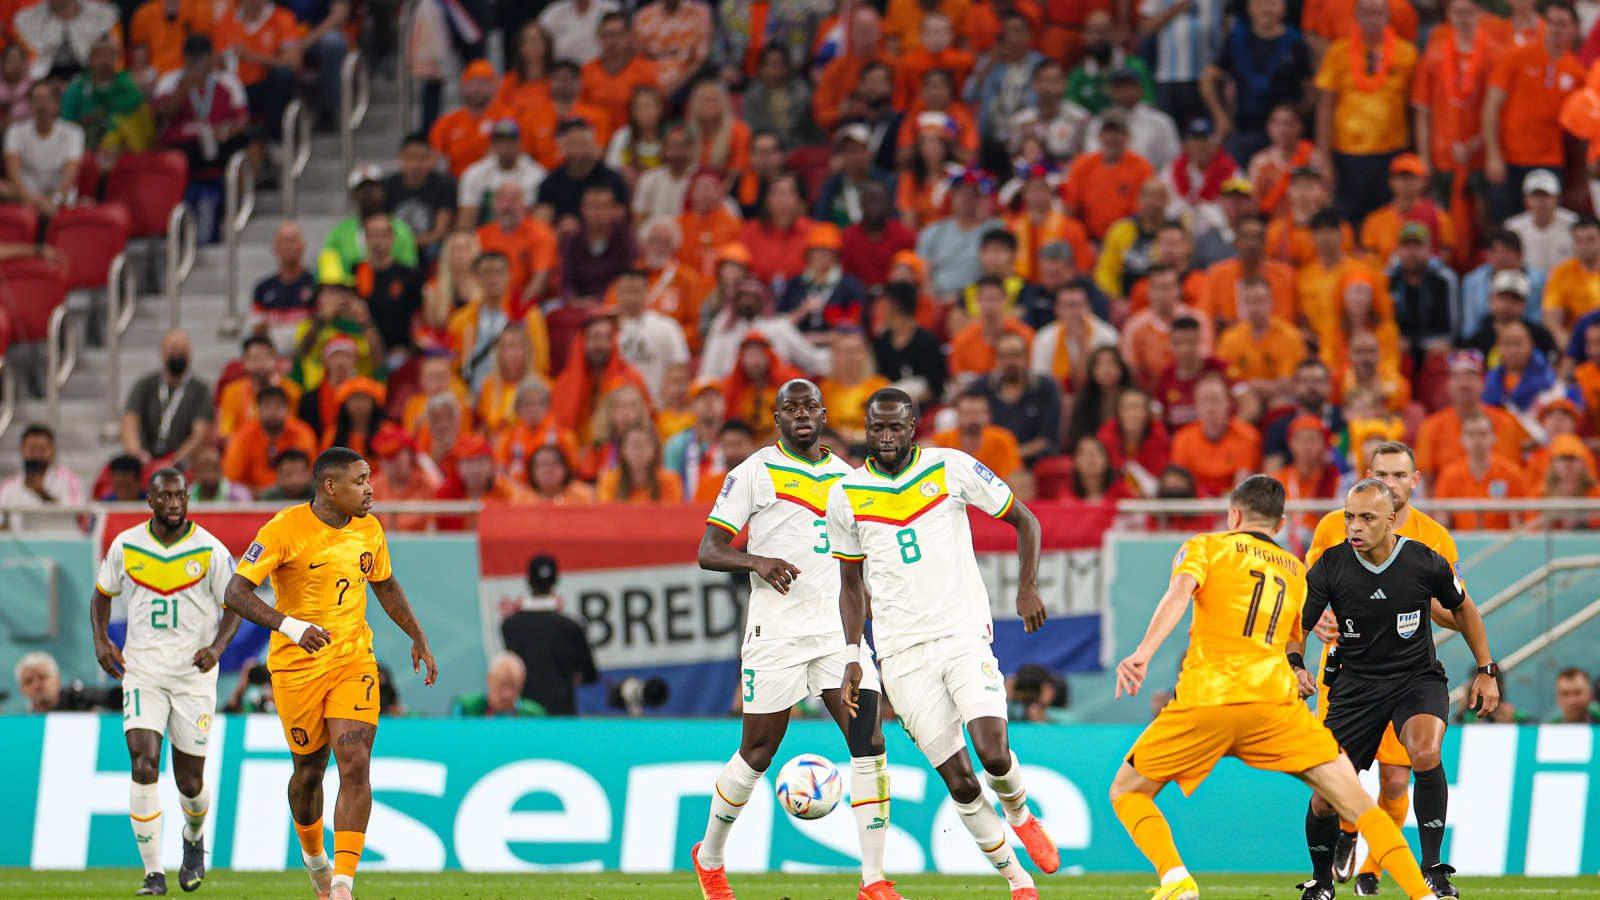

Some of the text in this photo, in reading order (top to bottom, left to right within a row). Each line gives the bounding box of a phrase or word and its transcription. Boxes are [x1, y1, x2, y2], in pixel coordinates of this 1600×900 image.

[813, 519, 831, 554] 3
[896, 528, 922, 564] 8
[1235, 541, 1298, 577] BERGHUIS
[335, 578, 350, 606] 7
[1242, 569, 1286, 645] 11
[151, 599, 178, 629] 21
[1399, 613, 1418, 622] FIFA
[361, 675, 375, 702] 7
[743, 668, 756, 703] 3
[30, 712, 1093, 873] Hisense
